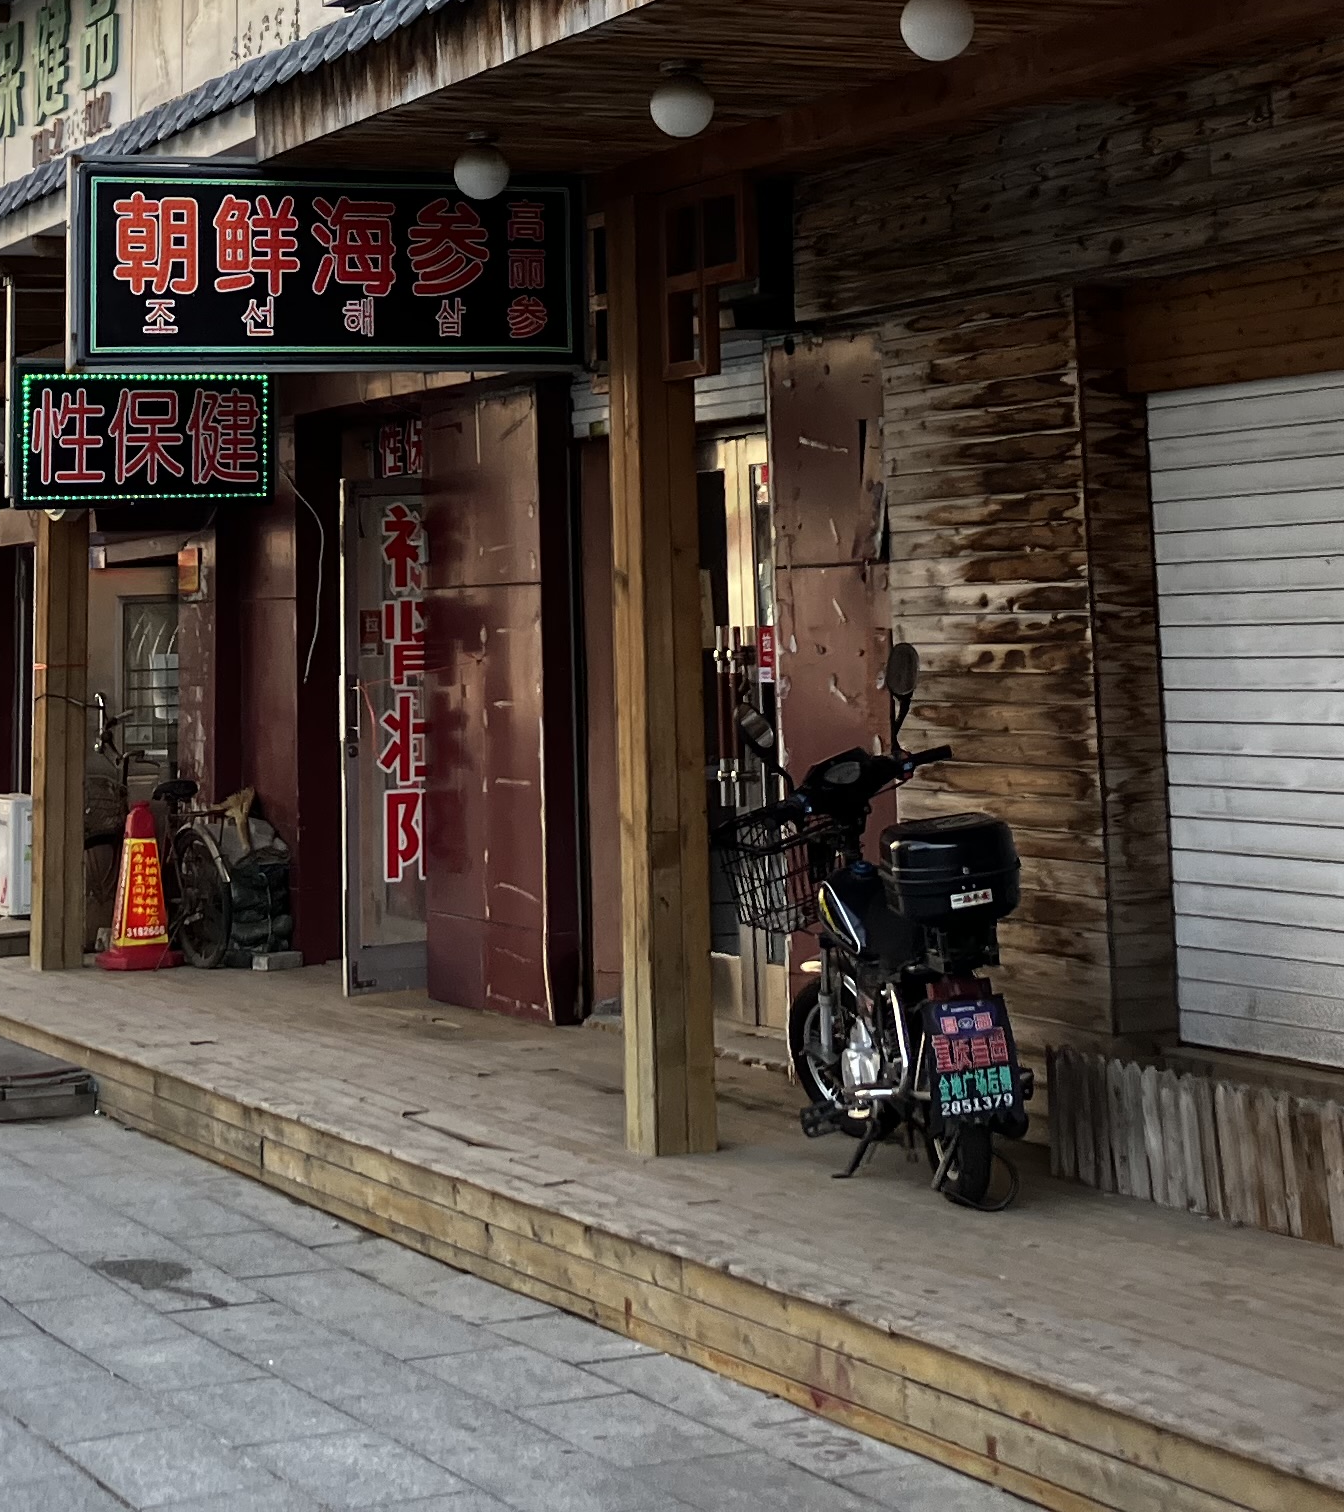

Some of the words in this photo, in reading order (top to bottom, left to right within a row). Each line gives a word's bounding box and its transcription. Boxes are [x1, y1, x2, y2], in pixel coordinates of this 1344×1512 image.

[112, 190, 490, 298] 朝鲜海参
[506, 199, 549, 339] 高丽参
[32, 387, 260, 485] 性保健
